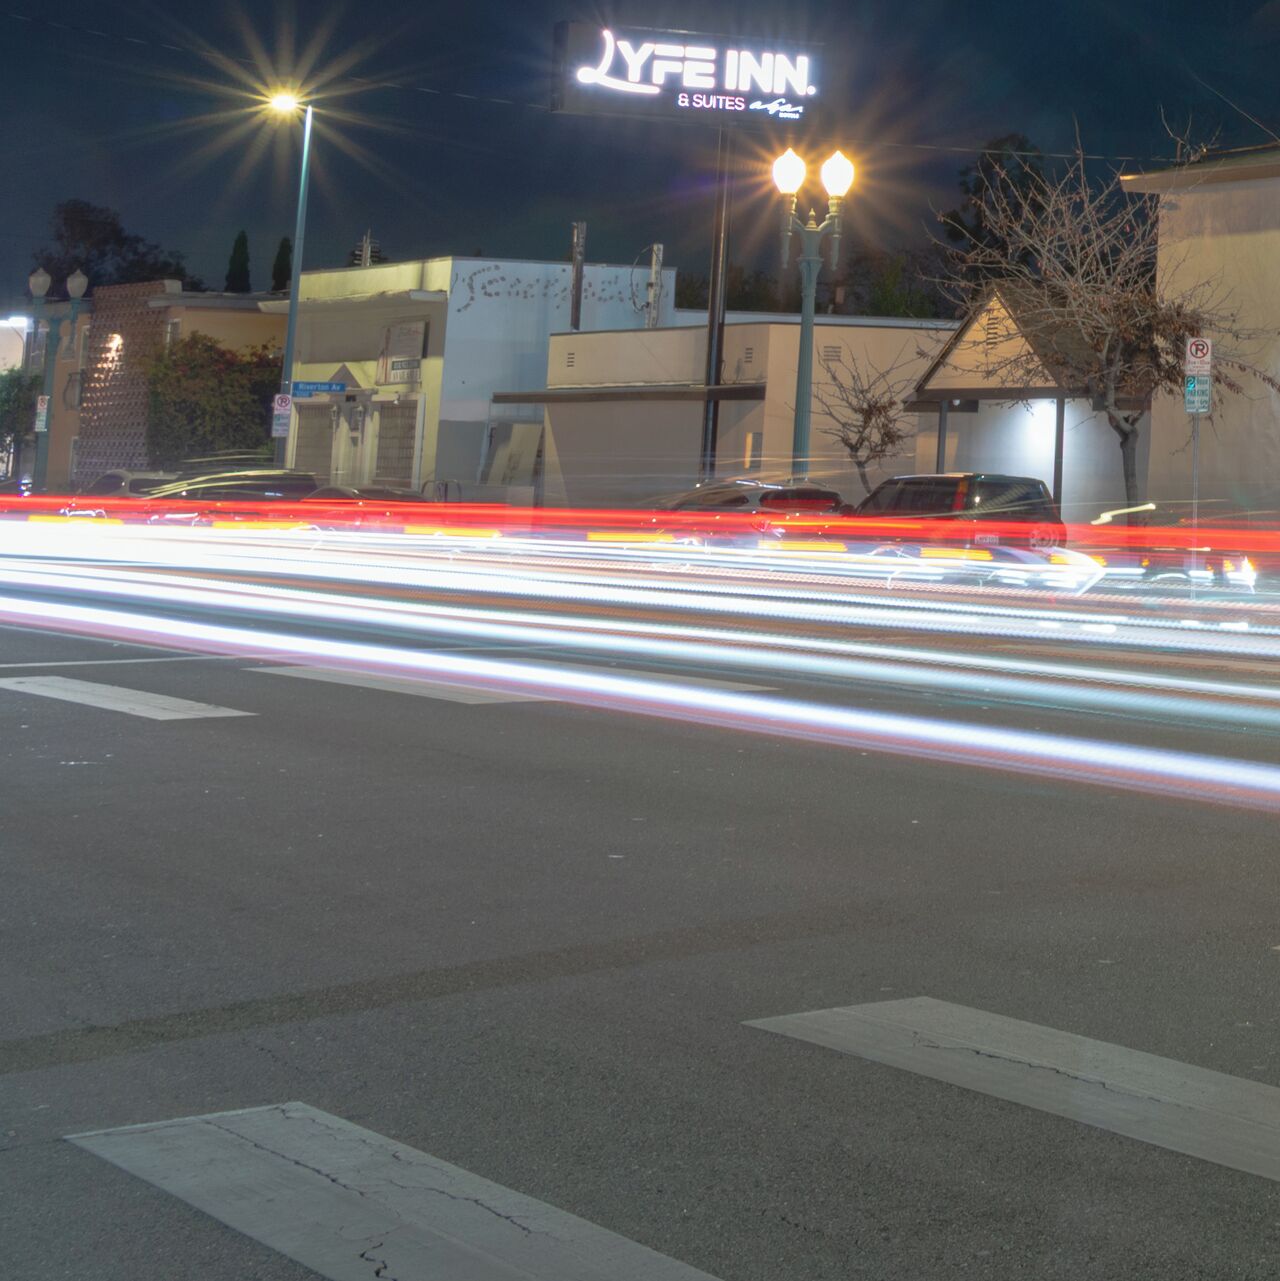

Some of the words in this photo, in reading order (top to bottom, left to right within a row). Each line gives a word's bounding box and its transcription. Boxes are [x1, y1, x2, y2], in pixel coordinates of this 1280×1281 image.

[577, 30, 716, 94] LYFE
[678, 93, 690, 107] &
[692, 94, 745, 111] SUITES
